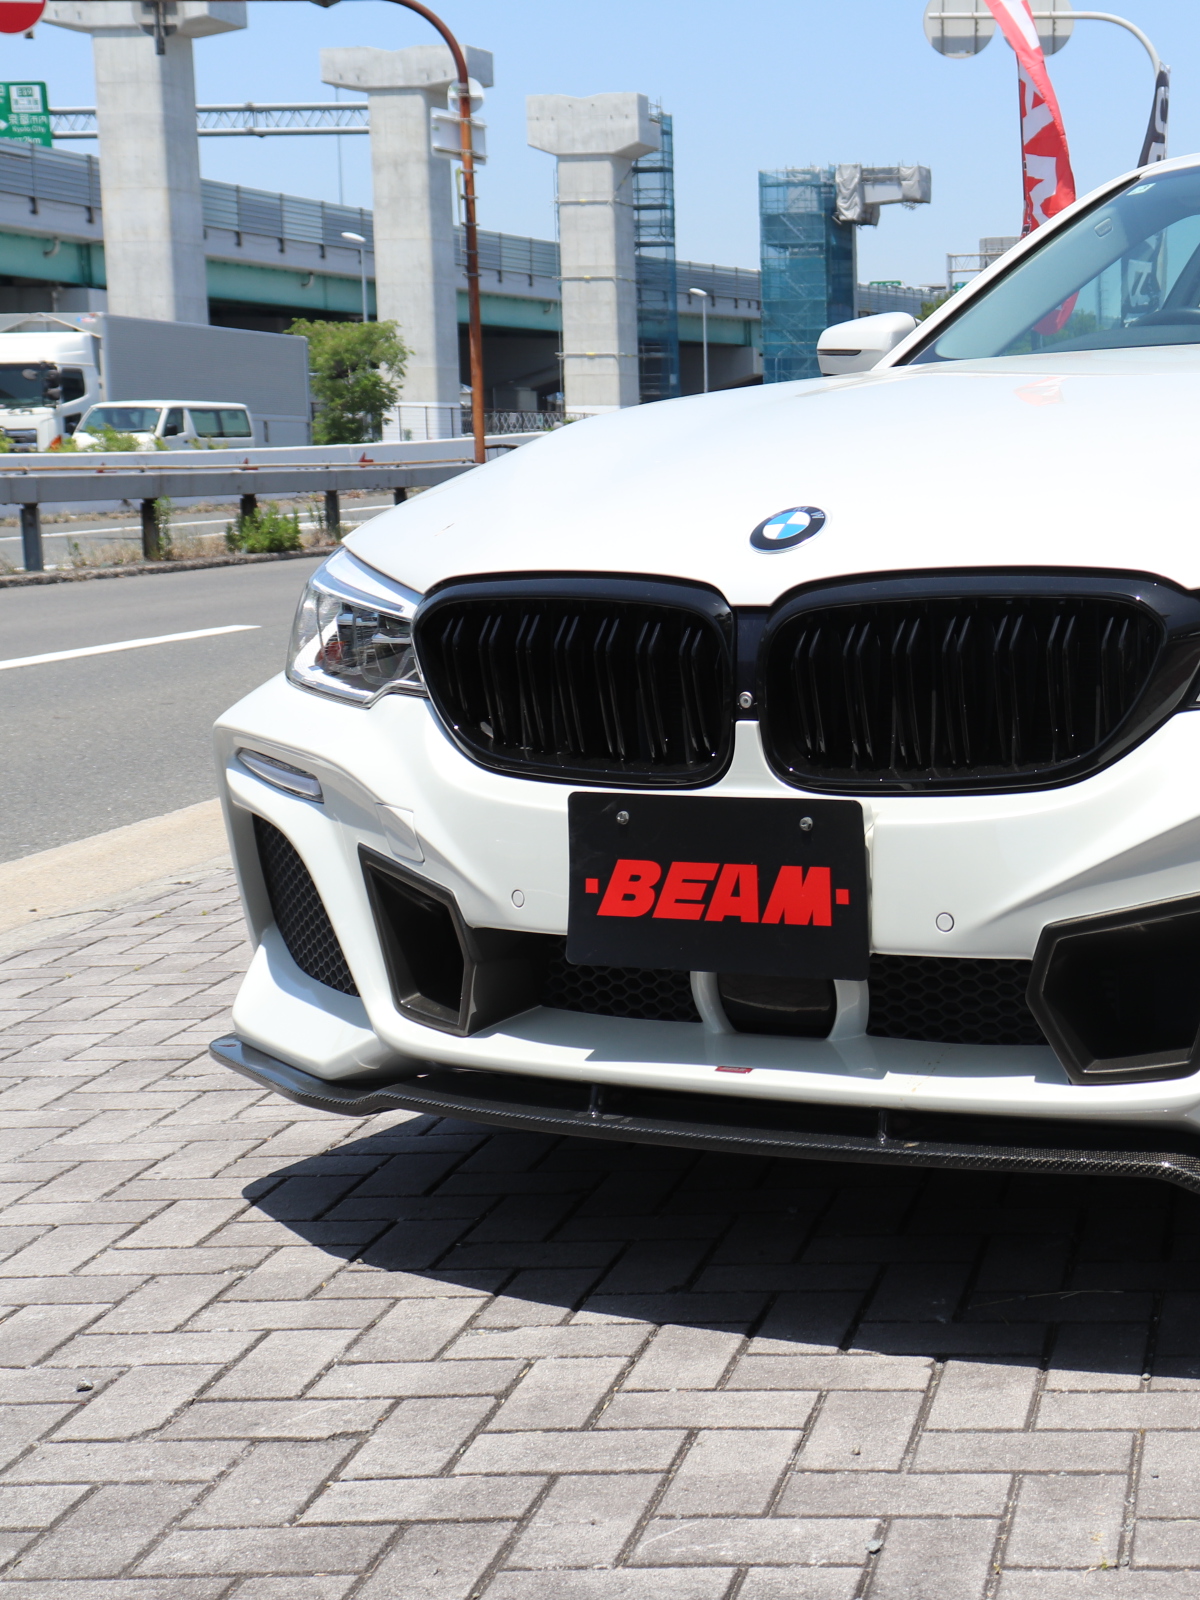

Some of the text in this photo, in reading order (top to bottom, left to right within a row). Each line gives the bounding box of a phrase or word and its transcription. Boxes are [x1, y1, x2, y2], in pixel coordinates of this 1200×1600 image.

[8, 113, 47, 125] 京都市内
[12, 125, 46, 133] Kyoto City
[597, 859, 832, 926] BEAM
